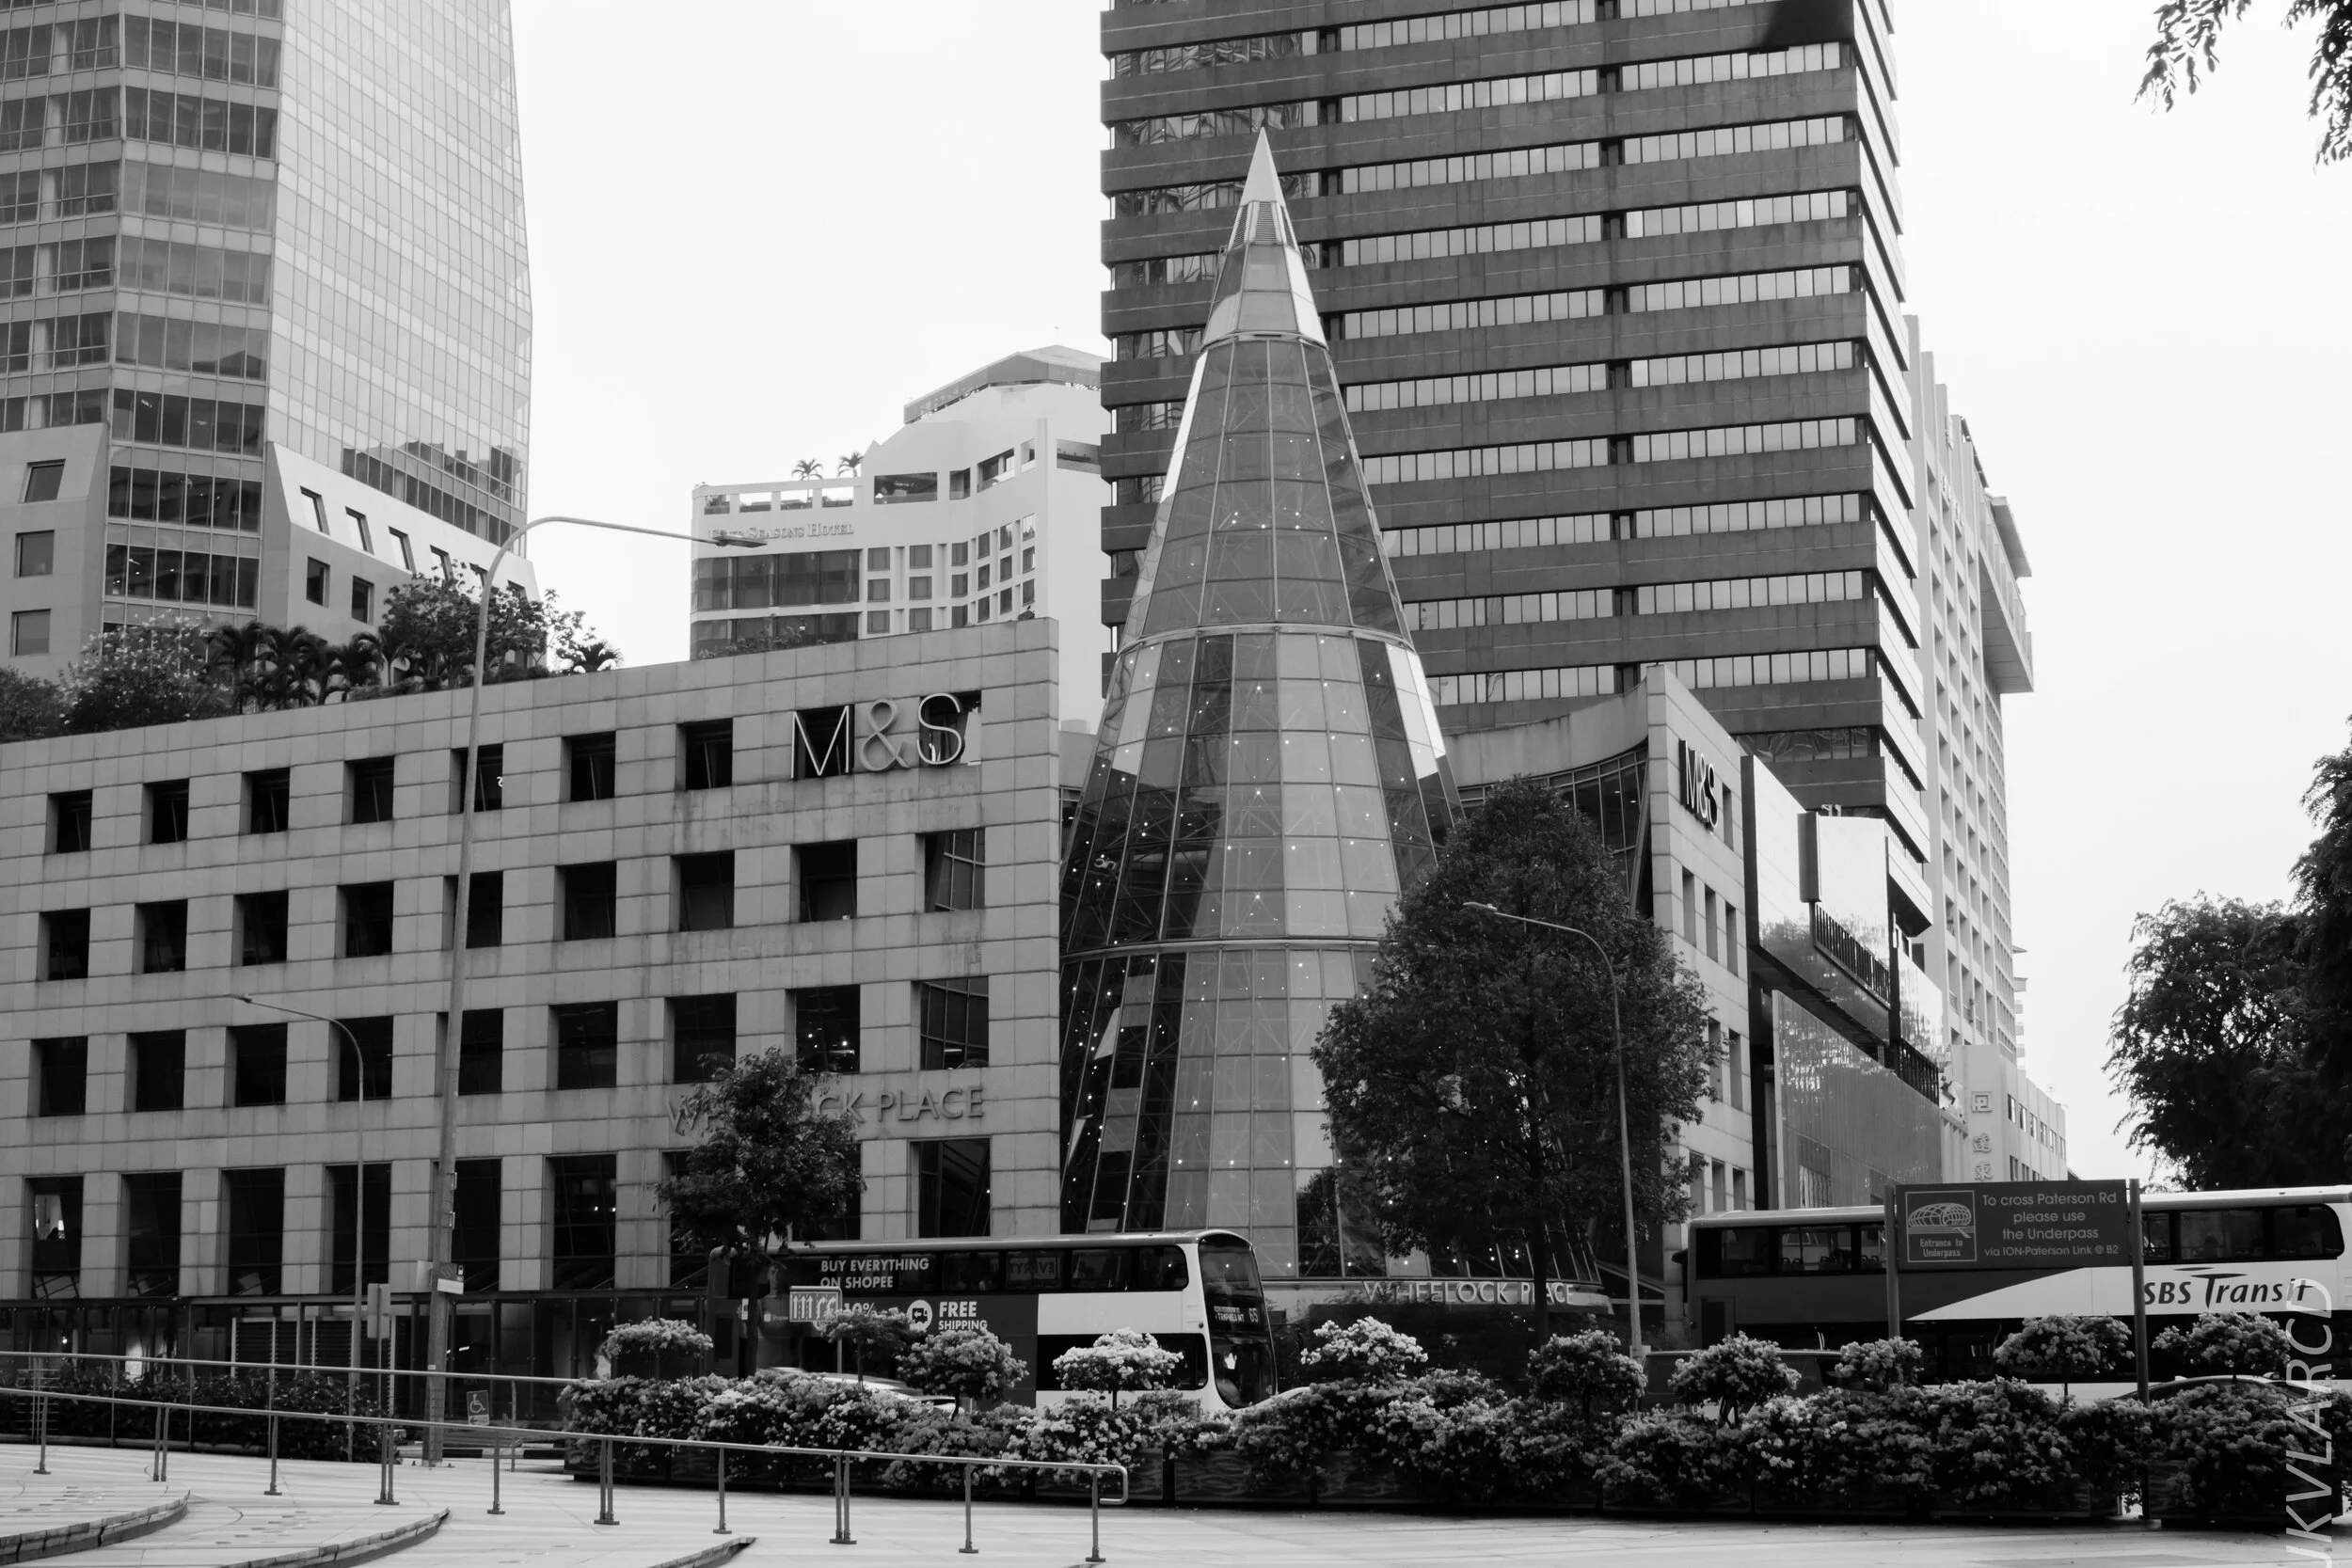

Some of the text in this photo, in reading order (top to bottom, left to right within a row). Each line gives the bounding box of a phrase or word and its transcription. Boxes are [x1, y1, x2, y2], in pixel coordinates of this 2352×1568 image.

[808, 523, 855, 538] HOTEL
[791, 692, 966, 781] M&S
[1679, 739, 1720, 830] M&S
[878, 1085, 985, 1123] PLACE
[1982, 1192, 2117, 1207] To cross Paterson Rd
[2013, 1211, 2087, 1226] please use
[2002, 1227, 2099, 1242] the Underpass
[1919, 1238, 1963, 1248] Entrance to
[1984, 1244, 2119, 1257] via ION-Paterson Link @ B2
[1922, 1248, 1961, 1259] Underpass
[820, 1257, 930, 1274] BUY EVERYTHING
[819, 1275, 894, 1290] ON SHOPEE
[1363, 1280, 1510, 1303] WHEELOCK
[2143, 1273, 2316, 1309] SBS Transit
[939, 1301, 977, 1318] FREE
[1248, 1307, 1259, 1323] 65
[938, 1320, 988, 1331] SHIPPING
